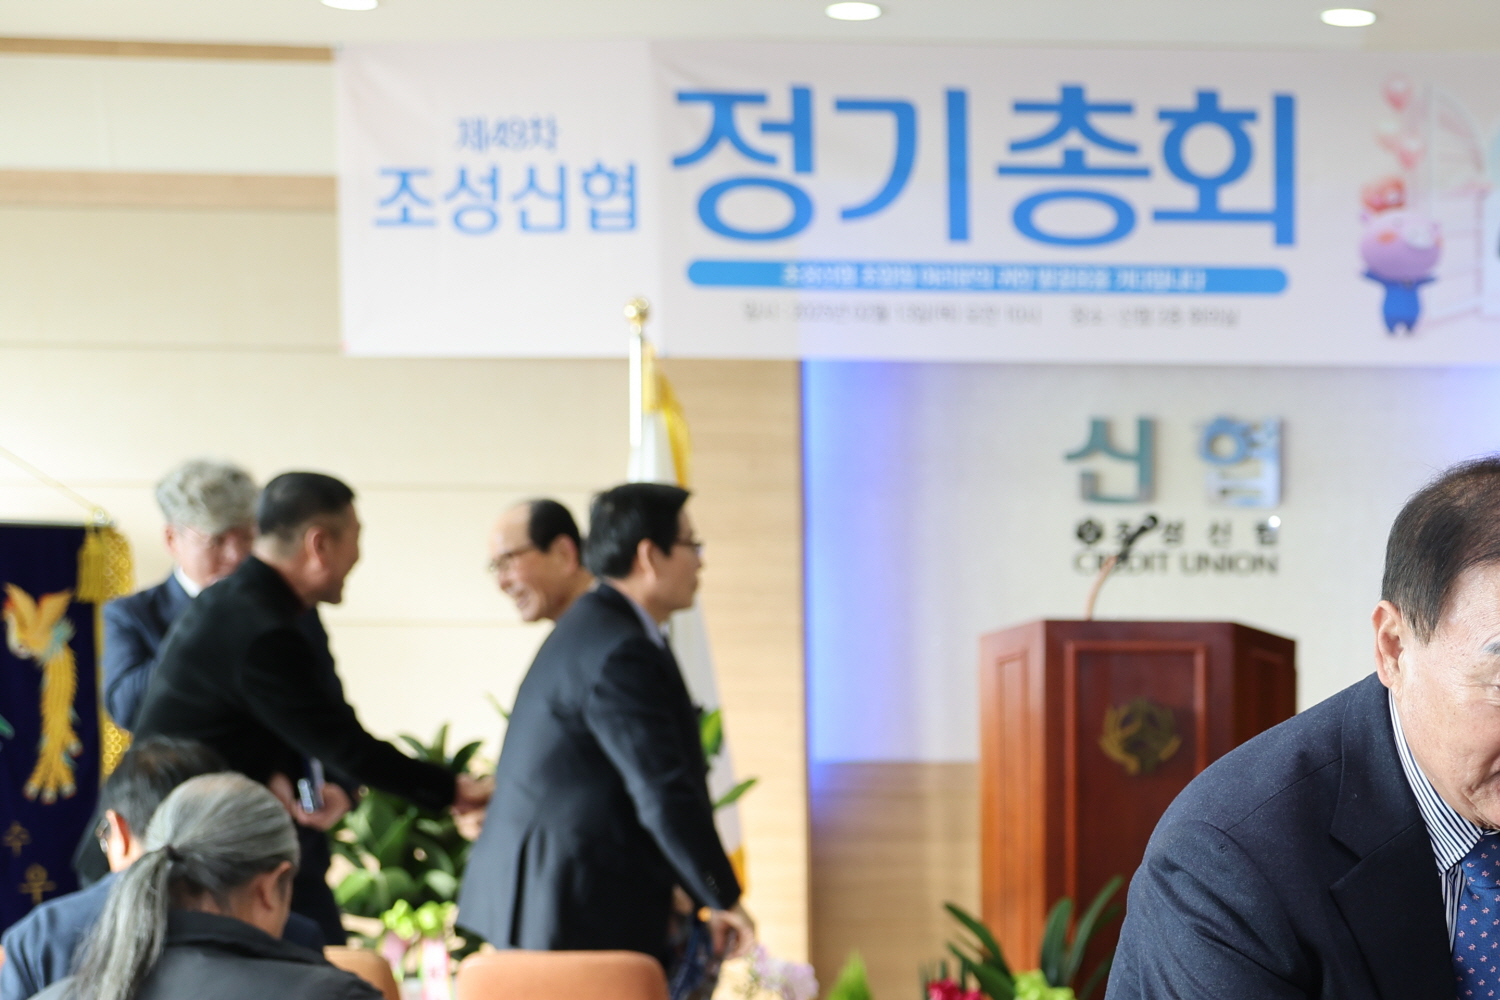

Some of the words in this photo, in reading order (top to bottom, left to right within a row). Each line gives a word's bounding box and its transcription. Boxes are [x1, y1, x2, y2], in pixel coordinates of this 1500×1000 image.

[455, 115, 559, 152] 제49차
[671, 85, 1296, 249] 정기총회
[373, 163, 638, 236] 조성신협
[1063, 415, 1281, 508] 신협
